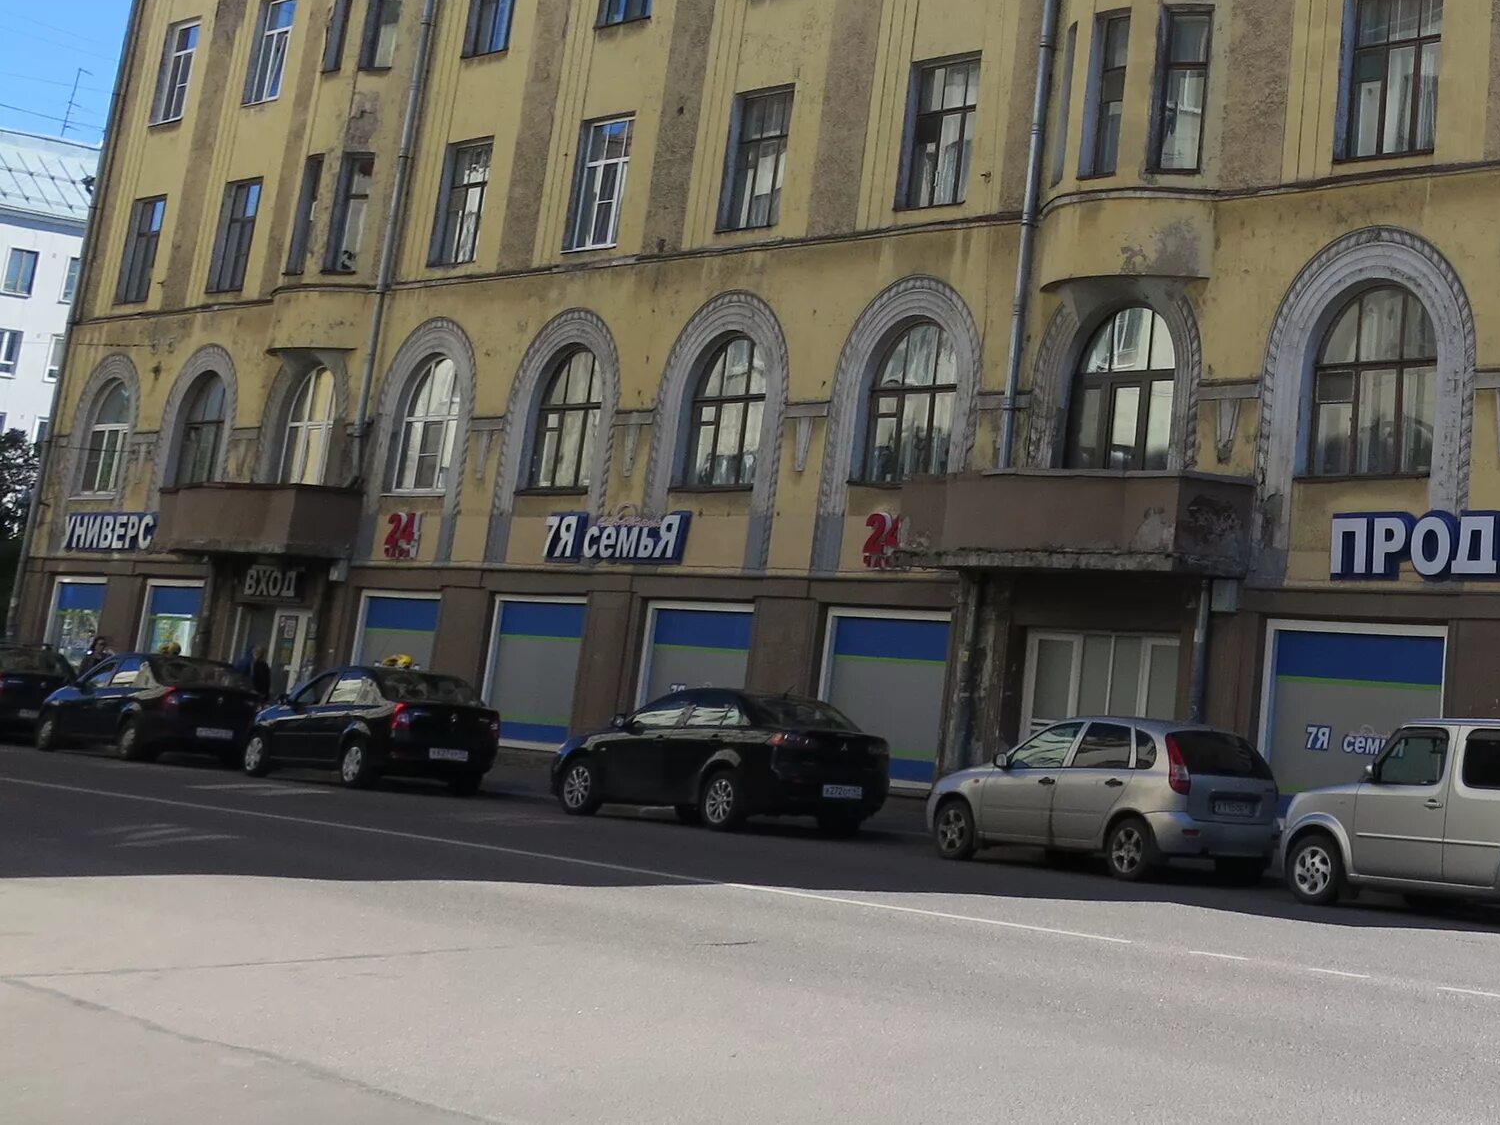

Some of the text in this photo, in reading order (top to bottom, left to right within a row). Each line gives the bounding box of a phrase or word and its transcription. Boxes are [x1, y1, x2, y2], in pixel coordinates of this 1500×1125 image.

[63, 514, 155, 550] УНИВЕРС
[384, 512, 417, 546] 24
[542, 515, 578, 558] 7Я
[583, 515, 682, 558] семьЯ
[244, 569, 297, 597] ВХОД
[1306, 726, 1331, 750] 7Я
